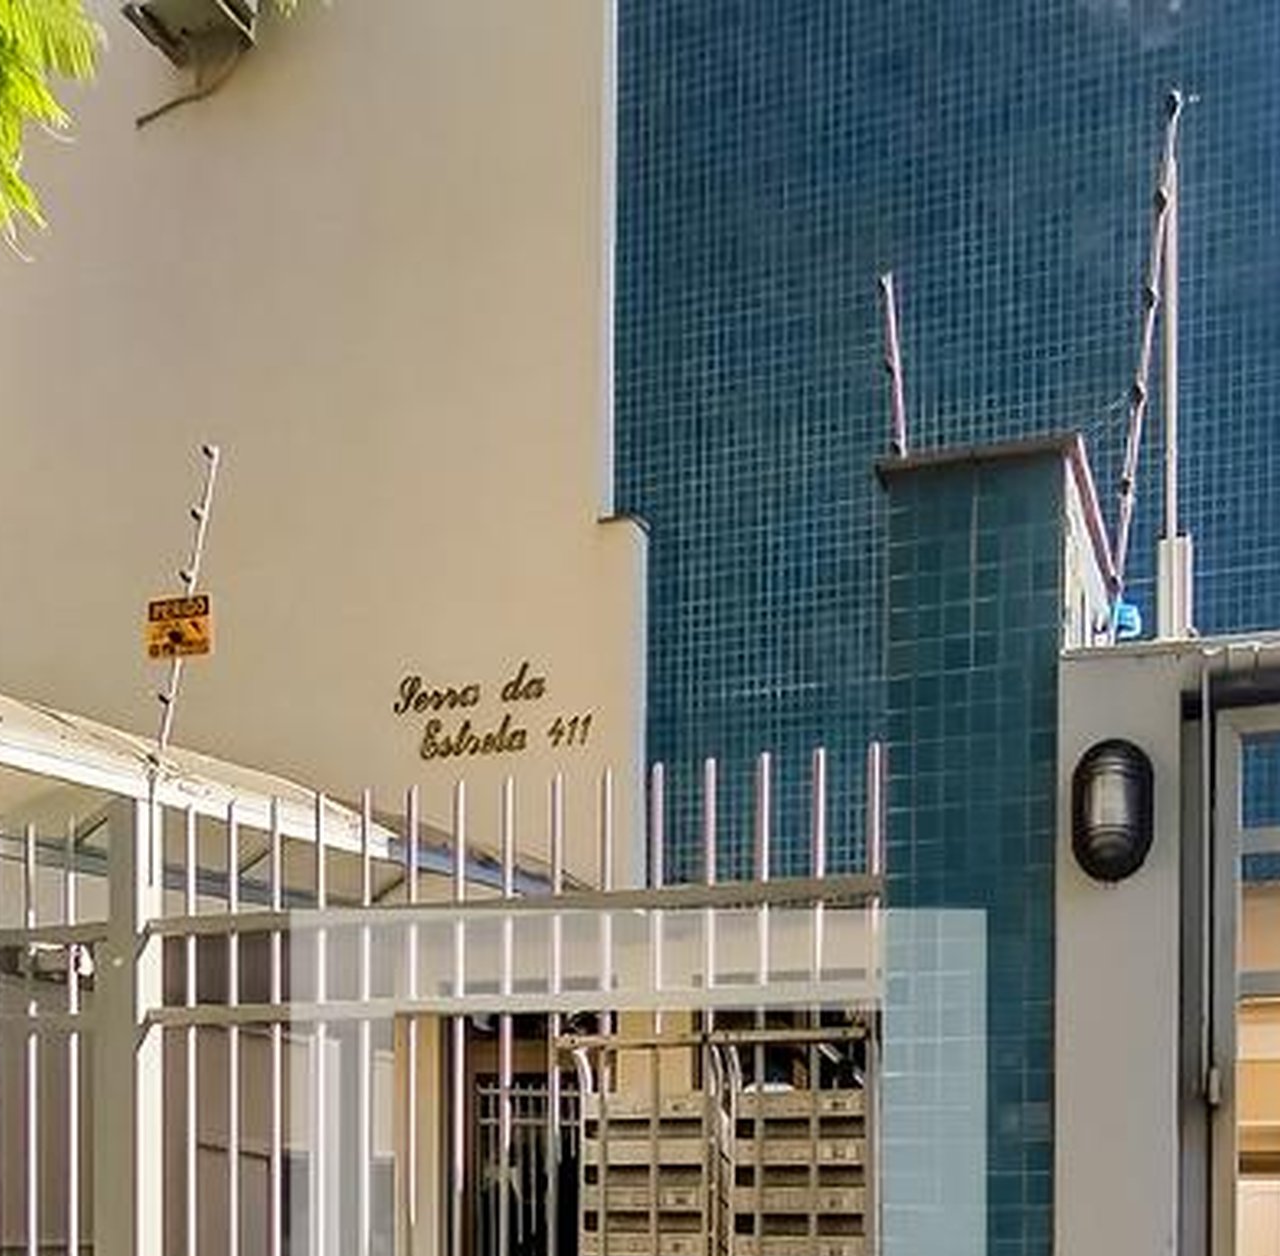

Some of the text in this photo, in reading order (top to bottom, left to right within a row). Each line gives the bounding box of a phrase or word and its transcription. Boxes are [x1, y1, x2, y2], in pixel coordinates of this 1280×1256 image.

[393, 661, 546, 715] Serra da
[420, 713, 592, 760] Estrela 411
